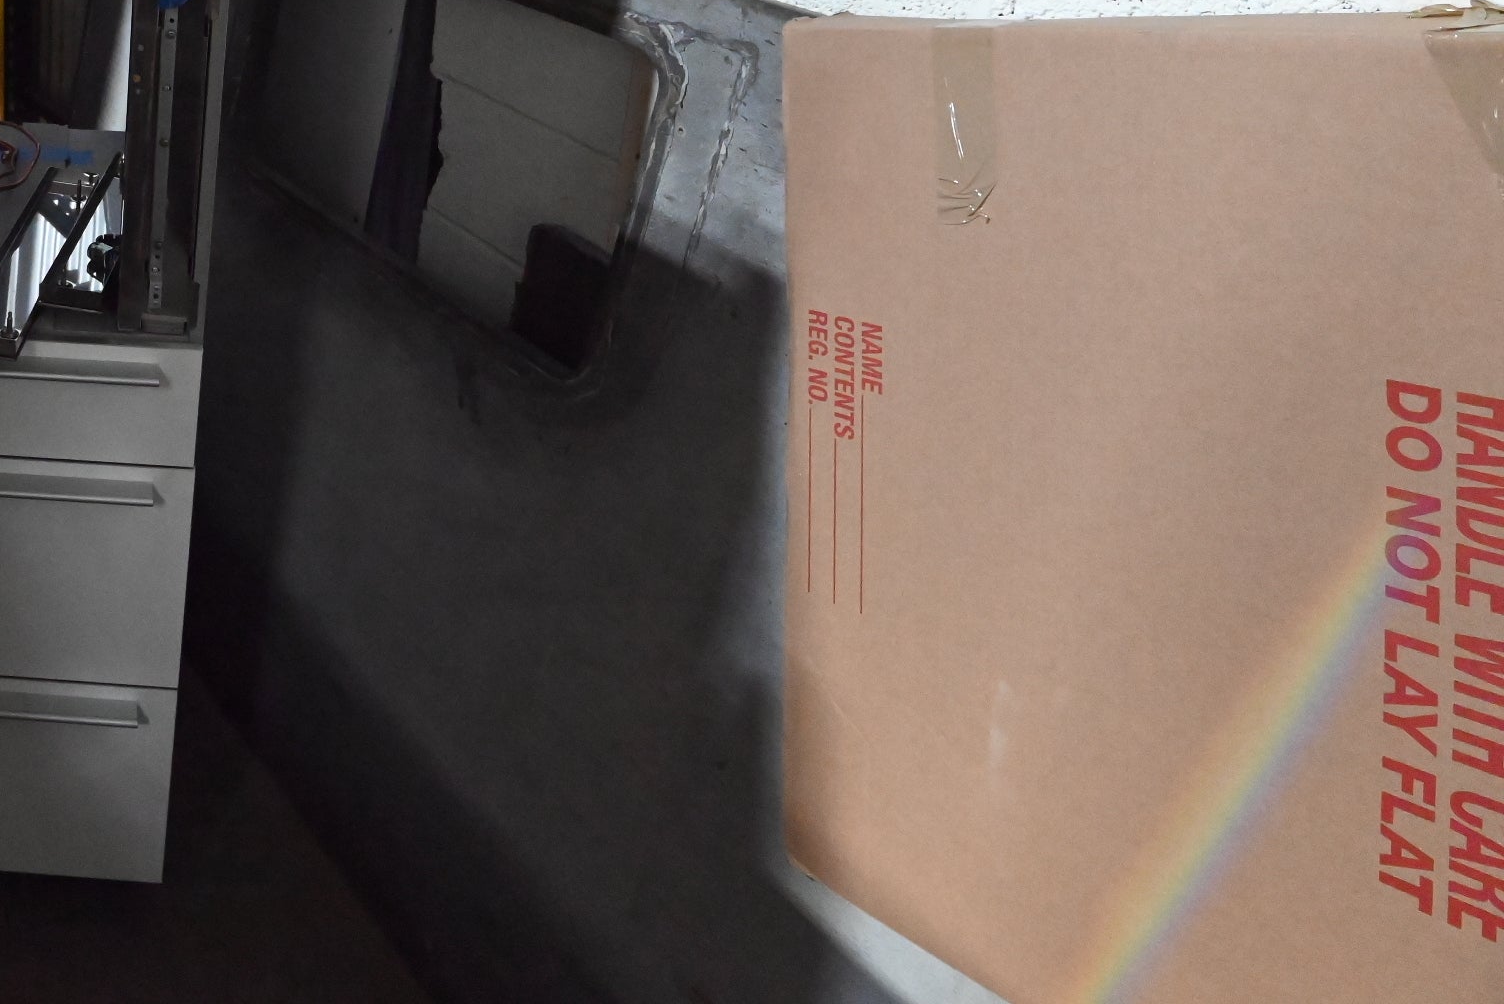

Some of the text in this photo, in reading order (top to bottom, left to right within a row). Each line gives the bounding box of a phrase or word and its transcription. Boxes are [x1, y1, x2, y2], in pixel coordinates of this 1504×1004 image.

[808, 309, 828, 405] REG. NO.
[834, 316, 855, 440] CONTENTS
[861, 321, 883, 395] NAME
[1378, 379, 1442, 916] DO NOT LAY FLAT
[1447, 391, 1504, 943] HANDLE WITH CARE
